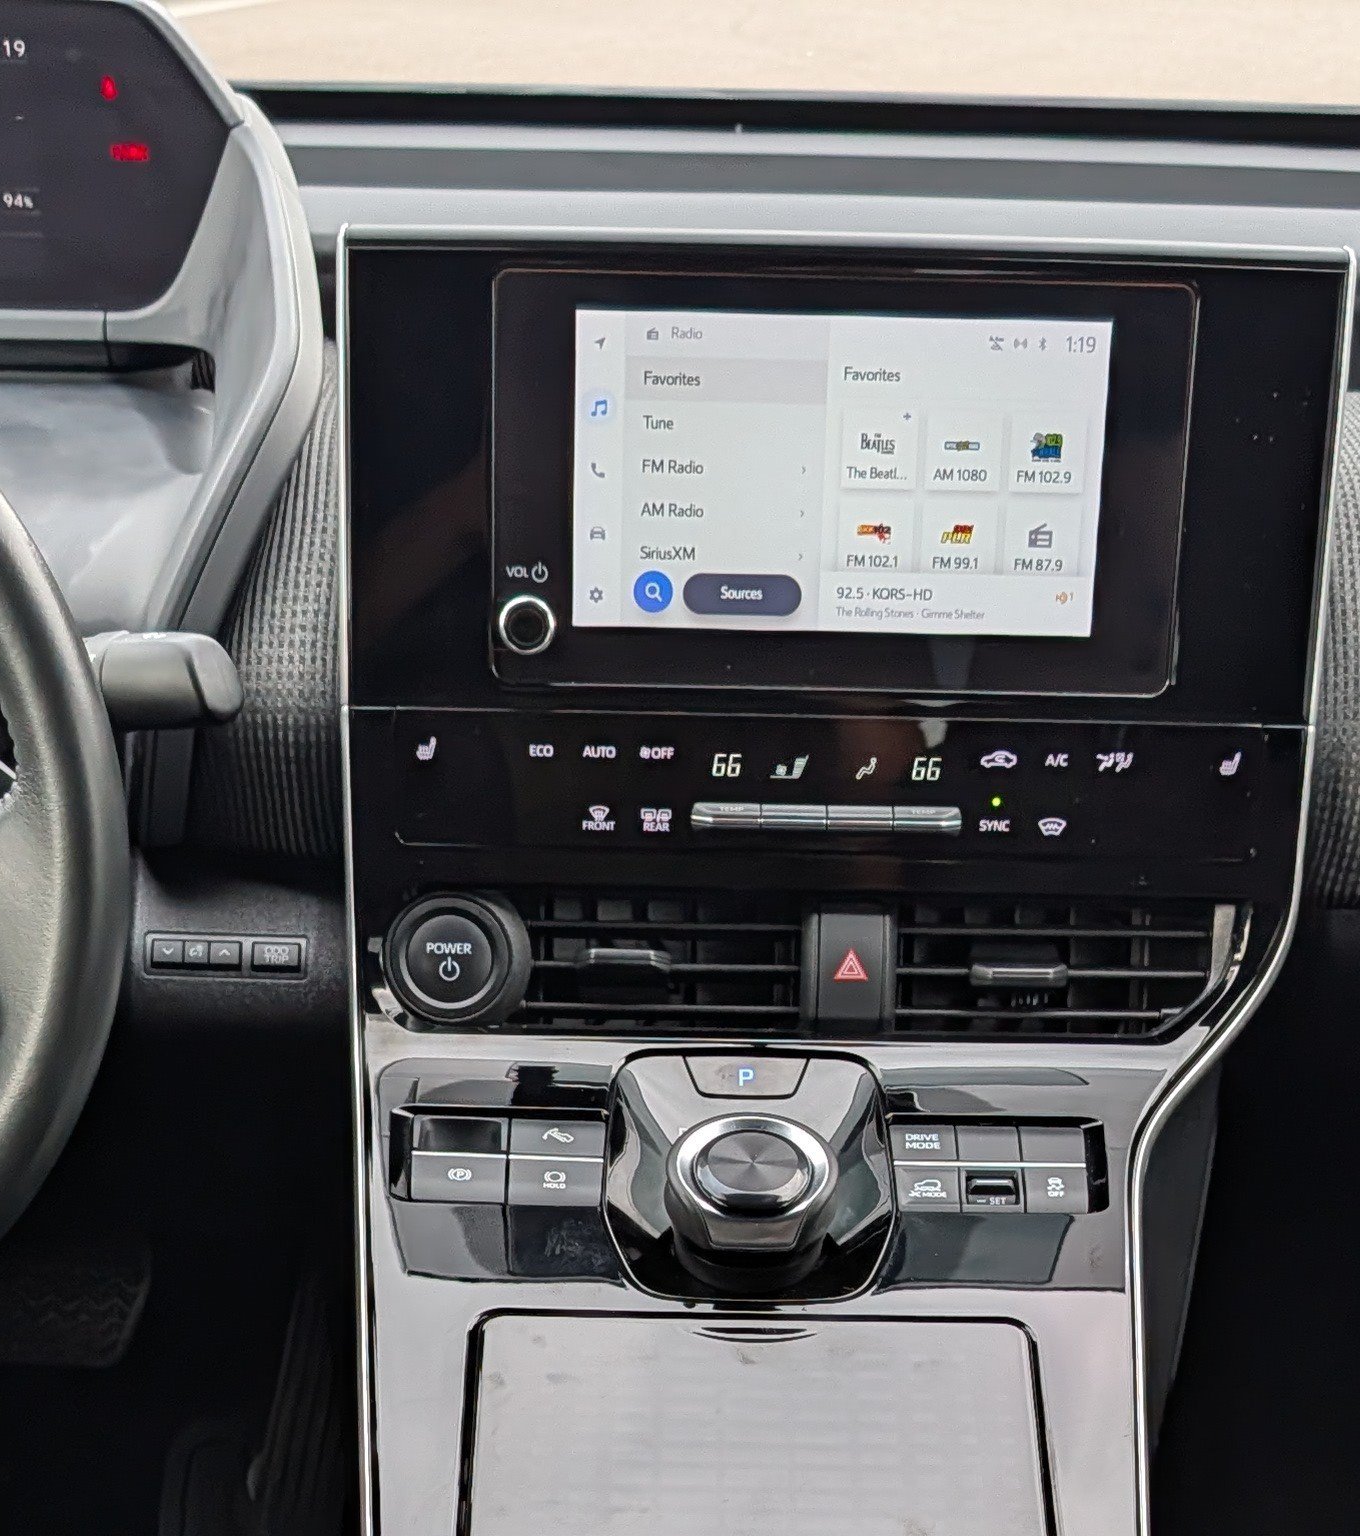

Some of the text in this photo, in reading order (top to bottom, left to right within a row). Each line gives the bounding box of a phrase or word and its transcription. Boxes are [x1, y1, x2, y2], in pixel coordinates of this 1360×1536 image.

[671, 326, 703, 340] Radio
[1066, 336, 1097, 354] 1:19
[643, 371, 701, 386] Favorites
[843, 366, 901, 383] Favorites
[643, 415, 674, 430] Tune
[642, 459, 704, 475] FM Radio
[847, 467, 866, 480] The
[933, 468, 988, 482] AM 1080
[1016, 470, 1072, 484] FM 102.9
[640, 503, 704, 518] AM Radio
[639, 546, 696, 561] SiriusXM
[846, 555, 899, 568] FM 102.1
[932, 557, 979, 570] FM 99.1
[1014, 558, 1063, 571] FM 87.9
[505, 565, 529, 578] VOL
[720, 586, 763, 601] Sources
[836, 587, 864, 600] 92.5
[835, 606, 853, 617] The
[884, 607, 914, 618] Stones
[529, 744, 554, 757] ECO
[582, 745, 617, 759] AUTO
[651, 746, 675, 760] OFF
[711, 753, 743, 778] 66
[1044, 753, 1069, 767] A/C
[911, 757, 943, 781] 66
[582, 820, 616, 831] FRONT
[643, 820, 671, 832] REAR
[979, 819, 1011, 832] SYNC
[425, 942, 472, 955] POWER
[264, 954, 289, 965] TRIP
[738, 1069, 754, 1086] P
[905, 1133, 939, 1141] DRIVE
[905, 1142, 941, 1150] MODE
[990, 1197, 1007, 1205] SET
